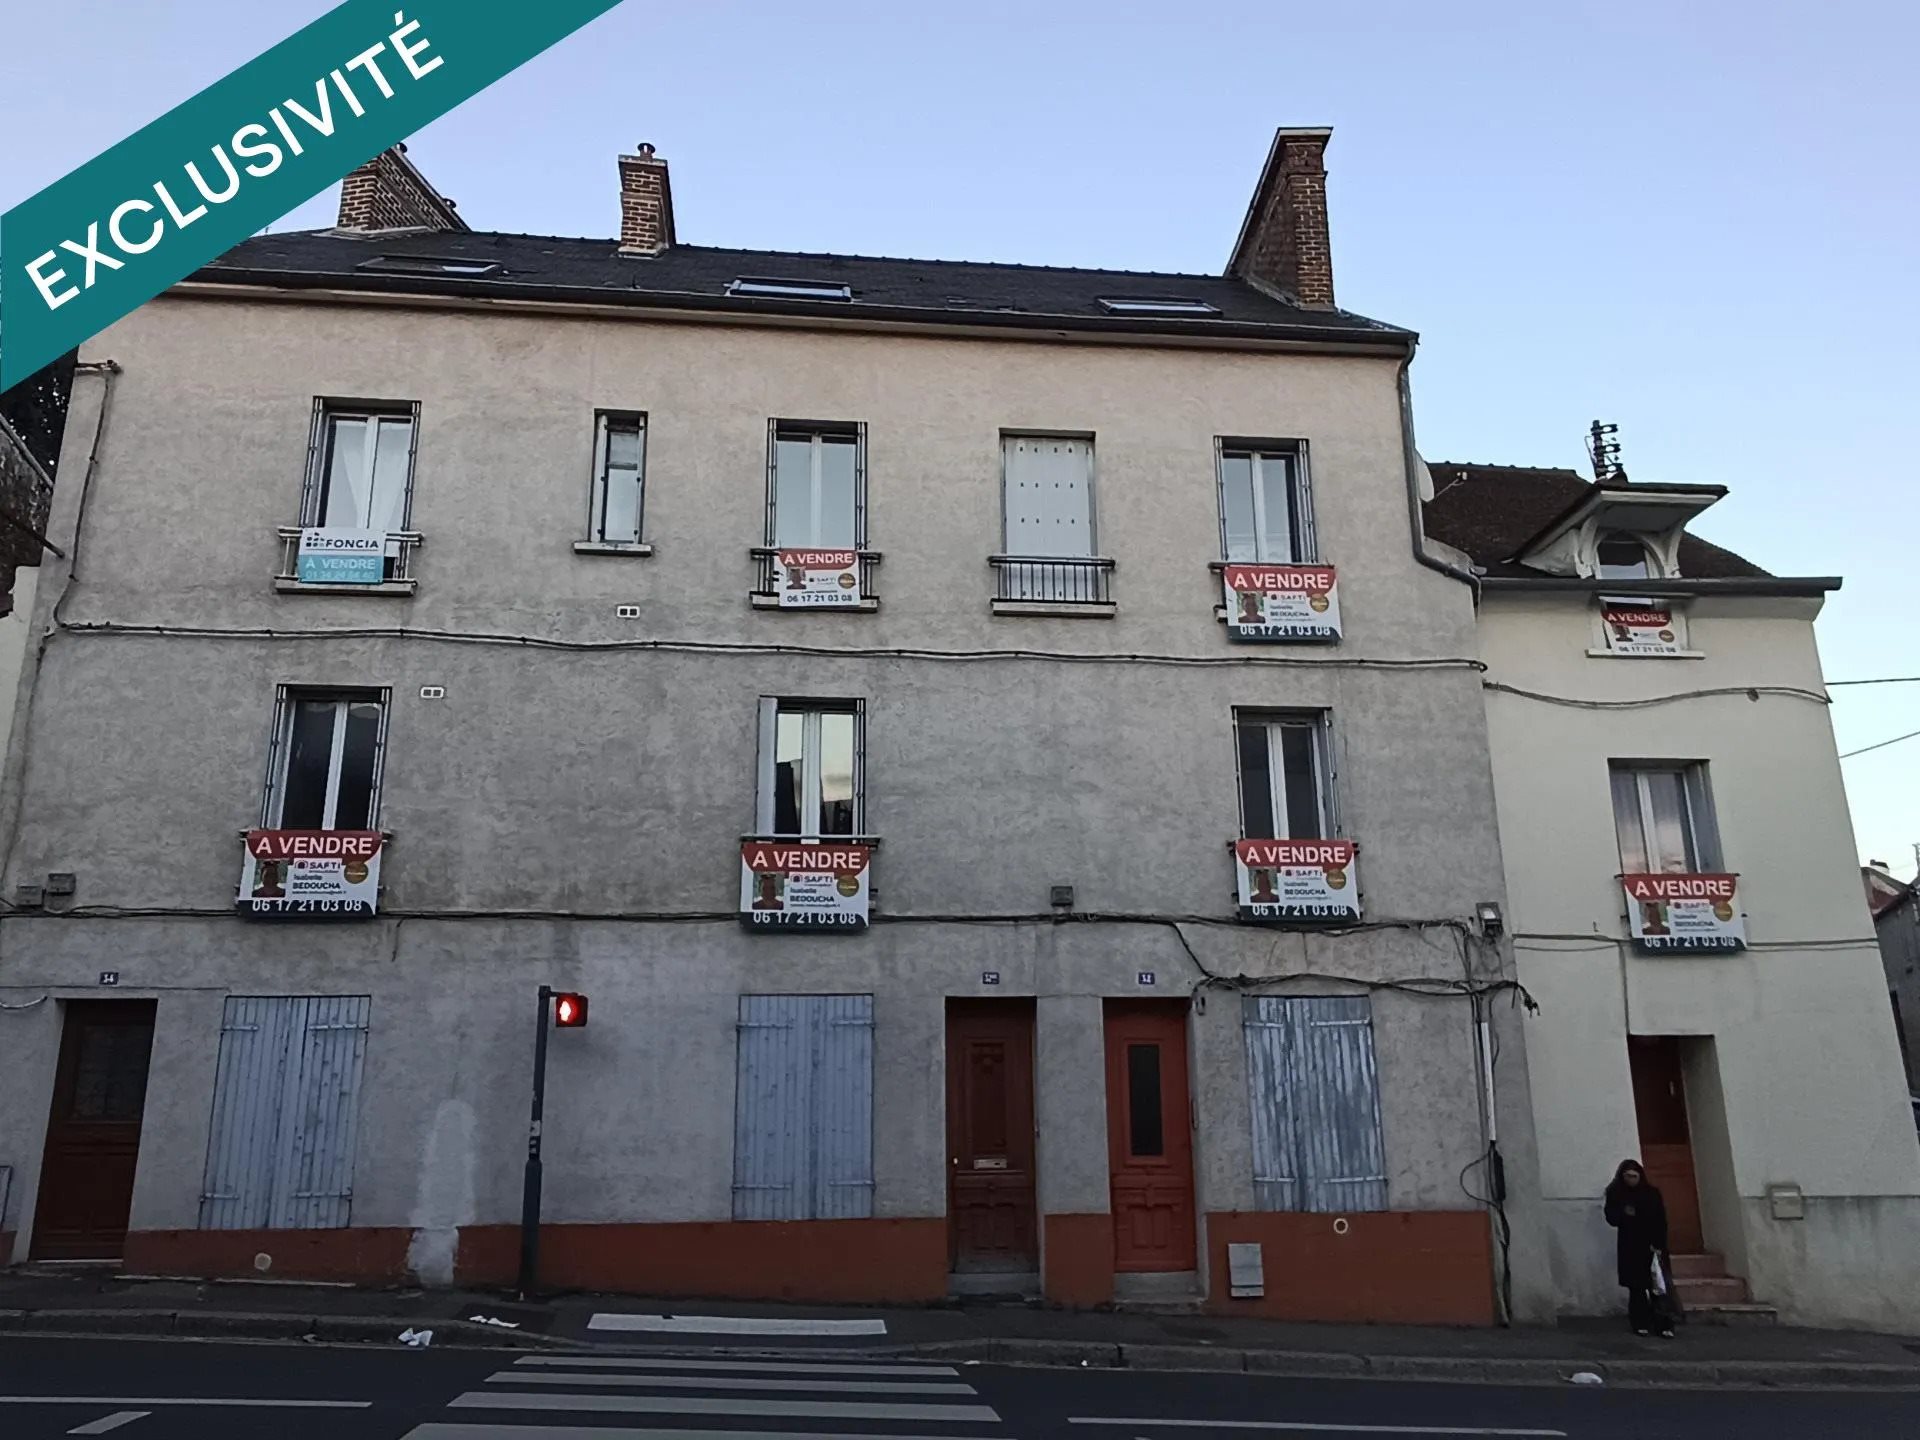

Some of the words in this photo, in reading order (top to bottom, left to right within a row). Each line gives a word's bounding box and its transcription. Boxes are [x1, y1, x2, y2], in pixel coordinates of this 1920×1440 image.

[326, 539, 379, 548] FONCIA
[322, 558, 376, 569] VENDRE
[784, 553, 795, 564] A
[797, 553, 853, 564] VENDRE
[1234, 573, 1248, 588] A
[1251, 573, 1329, 589] VENDRE
[815, 594, 824, 602] 21
[1608, 613, 1617, 622] A
[1617, 613, 1667, 622] VENDRE
[1240, 626, 1255, 636] 06
[1261, 626, 1272, 636] 17
[1278, 626, 1293, 636] 21
[1297, 626, 1312, 636] 03
[1315, 626, 1331, 636] 08
[256, 837, 272, 854] A
[279, 837, 373, 854] VENDRE
[752, 850, 768, 867] A
[773, 851, 861, 869] VENDRE
[1246, 847, 1260, 862] A
[1264, 847, 1346, 863] VENDRE
[804, 875, 833, 883] SAFTI
[1635, 880, 1650, 896] A
[1652, 880, 1732, 896] VENDRE
[252, 900, 271, 911] 06
[277, 900, 291, 911] 17
[297, 900, 315, 911] 21
[321, 900, 339, 911] 03
[344, 900, 362, 911] 08
[1252, 905, 1268, 916] 06
[1274, 905, 1287, 916] 17
[1293, 905, 1308, 916] 21
[1312, 905, 1328, 916] 03
[1332, 905, 1348, 916] 08
[753, 912, 771, 924] 06
[776, 912, 790, 924] 17
[796, 912, 812, 924] 21
[817, 912, 835, 924] 03
[840, 912, 856, 924] 08
[1644, 937, 1661, 947] 06
[1683, 937, 1698, 947] 21
